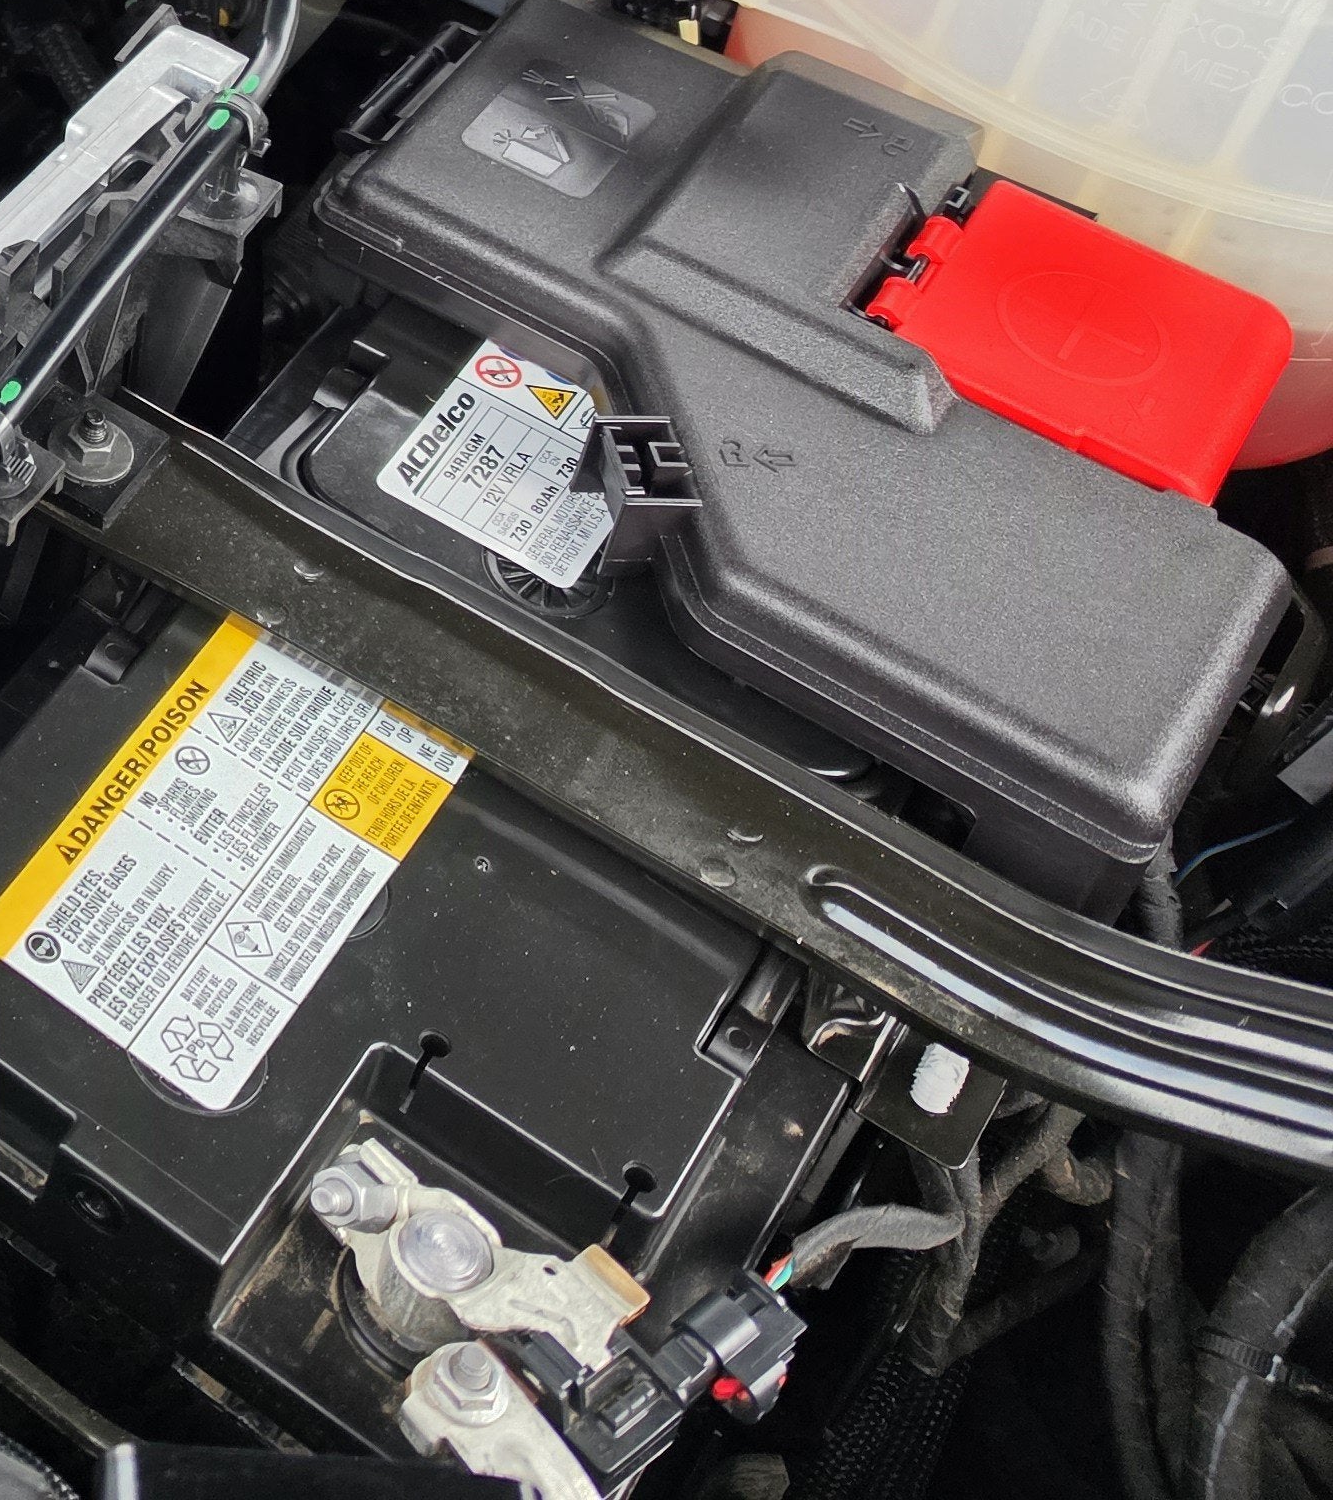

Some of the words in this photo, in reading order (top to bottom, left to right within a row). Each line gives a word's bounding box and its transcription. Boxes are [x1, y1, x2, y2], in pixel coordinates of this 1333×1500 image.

[396, 392, 476, 487] ACDelco
[538, 449, 553, 464] CCA
[443, 433, 486, 481] 94RAGM
[462, 444, 505, 489] 7287
[549, 455, 561, 466] EN
[556, 457, 578, 479] 730
[482, 483, 506, 507] 12V
[497, 451, 533, 485] VRLA
[530, 485, 560, 514] 80Ah
[491, 512, 506, 527] CCA
[509, 519, 533, 542] 730
[525, 524, 559, 561] GENERAL
[550, 492, 583, 526] MOTORS
[538, 551, 556, 569] 300
[549, 498, 595, 553] RENAISSANCE
[576, 526, 593, 542] MI
[223, 660, 267, 708] SULFURIC
[239, 689, 266, 717] ACID
[257, 672, 280, 694] CAN
[232, 718, 267, 753] CAUSE
[254, 677, 298, 726] BLINDNESS
[282, 685, 316, 719] BURNS.
[329, 689, 357, 716] CÉCIT
[257, 713, 292, 750] SEVERE
[262, 736, 298, 774] L'ACIDE
[287, 685, 337, 742] SULFURIQUE
[322, 712, 342, 729] LA
[374, 719, 396, 738] DO
[395, 724, 415, 744] OP
[248, 745, 268, 762] OR
[298, 724, 333, 761] CAUSER
[318, 713, 362, 763] BRÛLURES
[416, 743, 438, 762] NE
[67, 677, 211, 848] DANGER/POISON
[280, 756, 307, 784] PEUT
[305, 758, 329, 780] DES
[335, 764, 356, 786] KEEP
[348, 750, 368, 769] OUT
[358, 741, 373, 756] OF
[360, 755, 386, 783] REACH
[433, 746, 460, 773] OUV
[137, 790, 159, 810] NO
[156, 777, 189, 812] SPARKS
[296, 774, 316, 793] OU
[351, 777, 370, 795] THE
[366, 790, 382, 805] OF
[393, 787, 411, 803] DE
[400, 778, 418, 792] LA
[168, 785, 202, 820] FLAMES
[181, 787, 218, 828] SMOKING
[224, 781, 272, 834] ÉTINCELLES
[378, 798, 403, 822] HORS
[189, 802, 229, 846] ÉVITER
[213, 829, 236, 851] LES
[226, 838, 249, 860] LES
[239, 797, 279, 843] FLAMMES
[249, 820, 282, 856] FUMER
[364, 817, 389, 841] TENIR
[379, 819, 409, 852] PORTÉE
[399, 809, 416, 825] DE
[240, 850, 260, 869] DE
[241, 882, 270, 914] FLUSH
[260, 865, 284, 890] EYES
[273, 816, 317, 871] IMMEDIATELY
[320, 843, 346, 868] FAST.
[307, 862, 330, 887] HELP
[45, 894, 82, 934] SHIELD
[72, 868, 106, 900] EYES.
[60, 885, 113, 945] EXPLOSIVE
[102, 853, 137, 891] GASES
[91, 910, 140, 967] BLINDNESS
[131, 896, 151, 915] OR
[141, 862, 179, 902] INJURY.
[256, 897, 283, 923] WITH
[271, 873, 303, 903] WATER.
[283, 882, 318, 919] MEDICAL
[307, 896, 332, 921] L'EAU
[77, 930, 101, 955] CAN
[92, 899, 125, 935] CAUSE
[273, 912, 294, 934] GET
[290, 920, 314, 944] YEUX
[85, 949, 137, 1010] PROTÉGEZ
[125, 931, 152, 956] LES
[140, 902, 176, 935] YEUX.
[102, 995, 128, 1022] LES
[118, 971, 146, 1000] GAZ
[134, 918, 186, 978] EXPLOSIFS
[176, 877, 217, 925] PEUVENT
[118, 984, 161, 1032] BLESSER
[151, 967, 171, 989] OU
[162, 930, 200, 975] RENDRE
[190, 889, 233, 938] AVEUGLE.
[279, 948, 317, 992] CONSULTEZ
[306, 937, 325, 954] UN
[280, 939, 301, 958] LES
[179, 964, 211, 1003] BATTERY
[263, 951, 292, 982] RINCEZ
[191, 983, 215, 1011] MUST
[207, 973, 223, 989] BE
[203, 977, 238, 1020] RECYCLED
[228, 980, 262, 1019] BATTERIE
[220, 1016, 237, 1031] LA
[233, 1015, 254, 1039] DOIT
[185, 1038, 208, 1059] Pb
